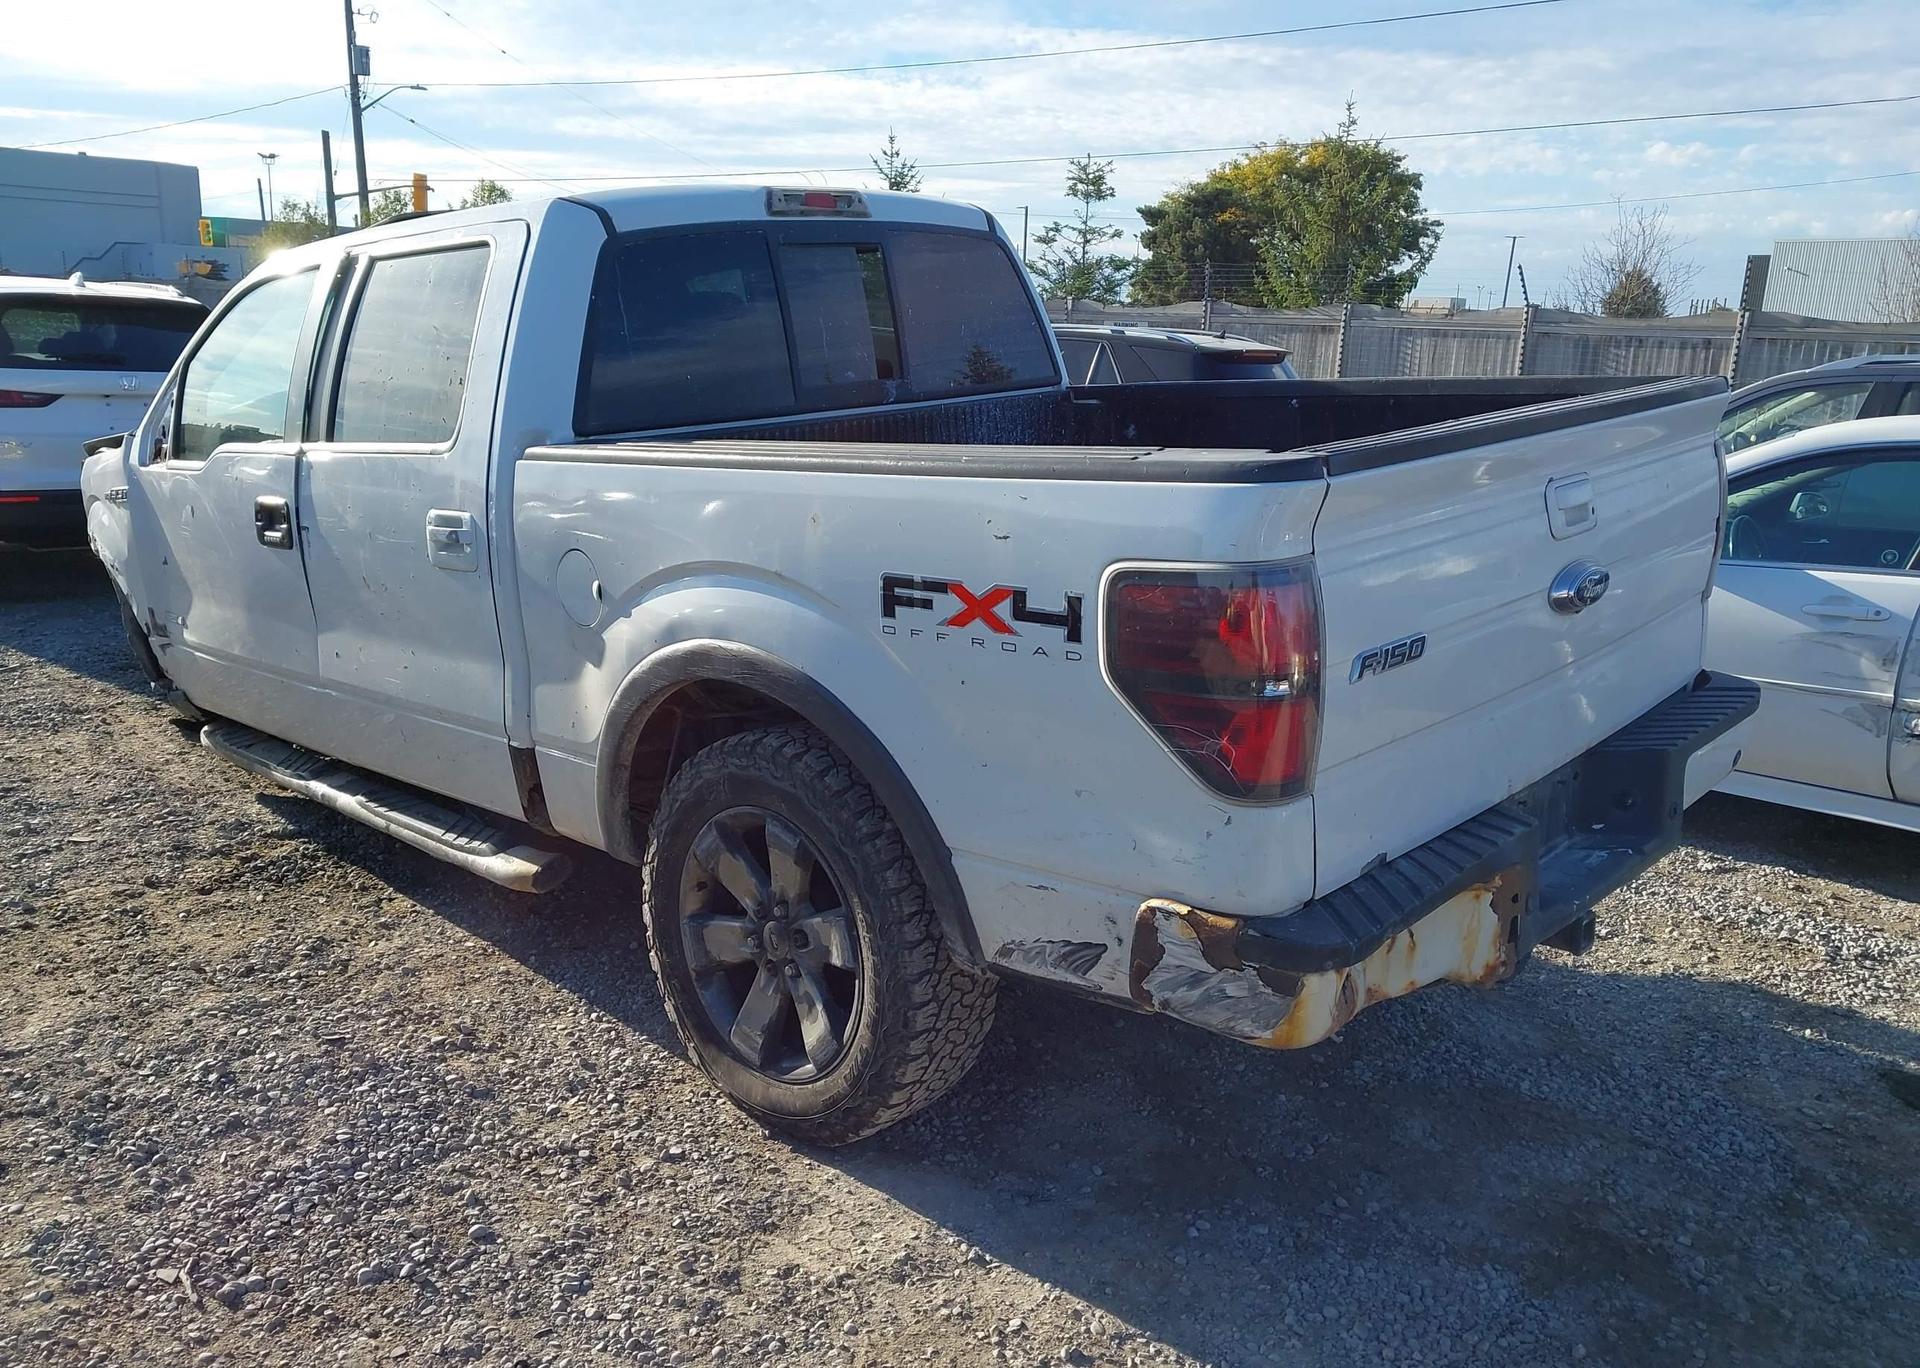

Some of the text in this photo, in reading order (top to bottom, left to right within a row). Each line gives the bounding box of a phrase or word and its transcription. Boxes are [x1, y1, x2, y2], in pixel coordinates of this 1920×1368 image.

[880, 572, 1083, 644] FX4
[882, 625, 1082, 661] OFF ROAD
